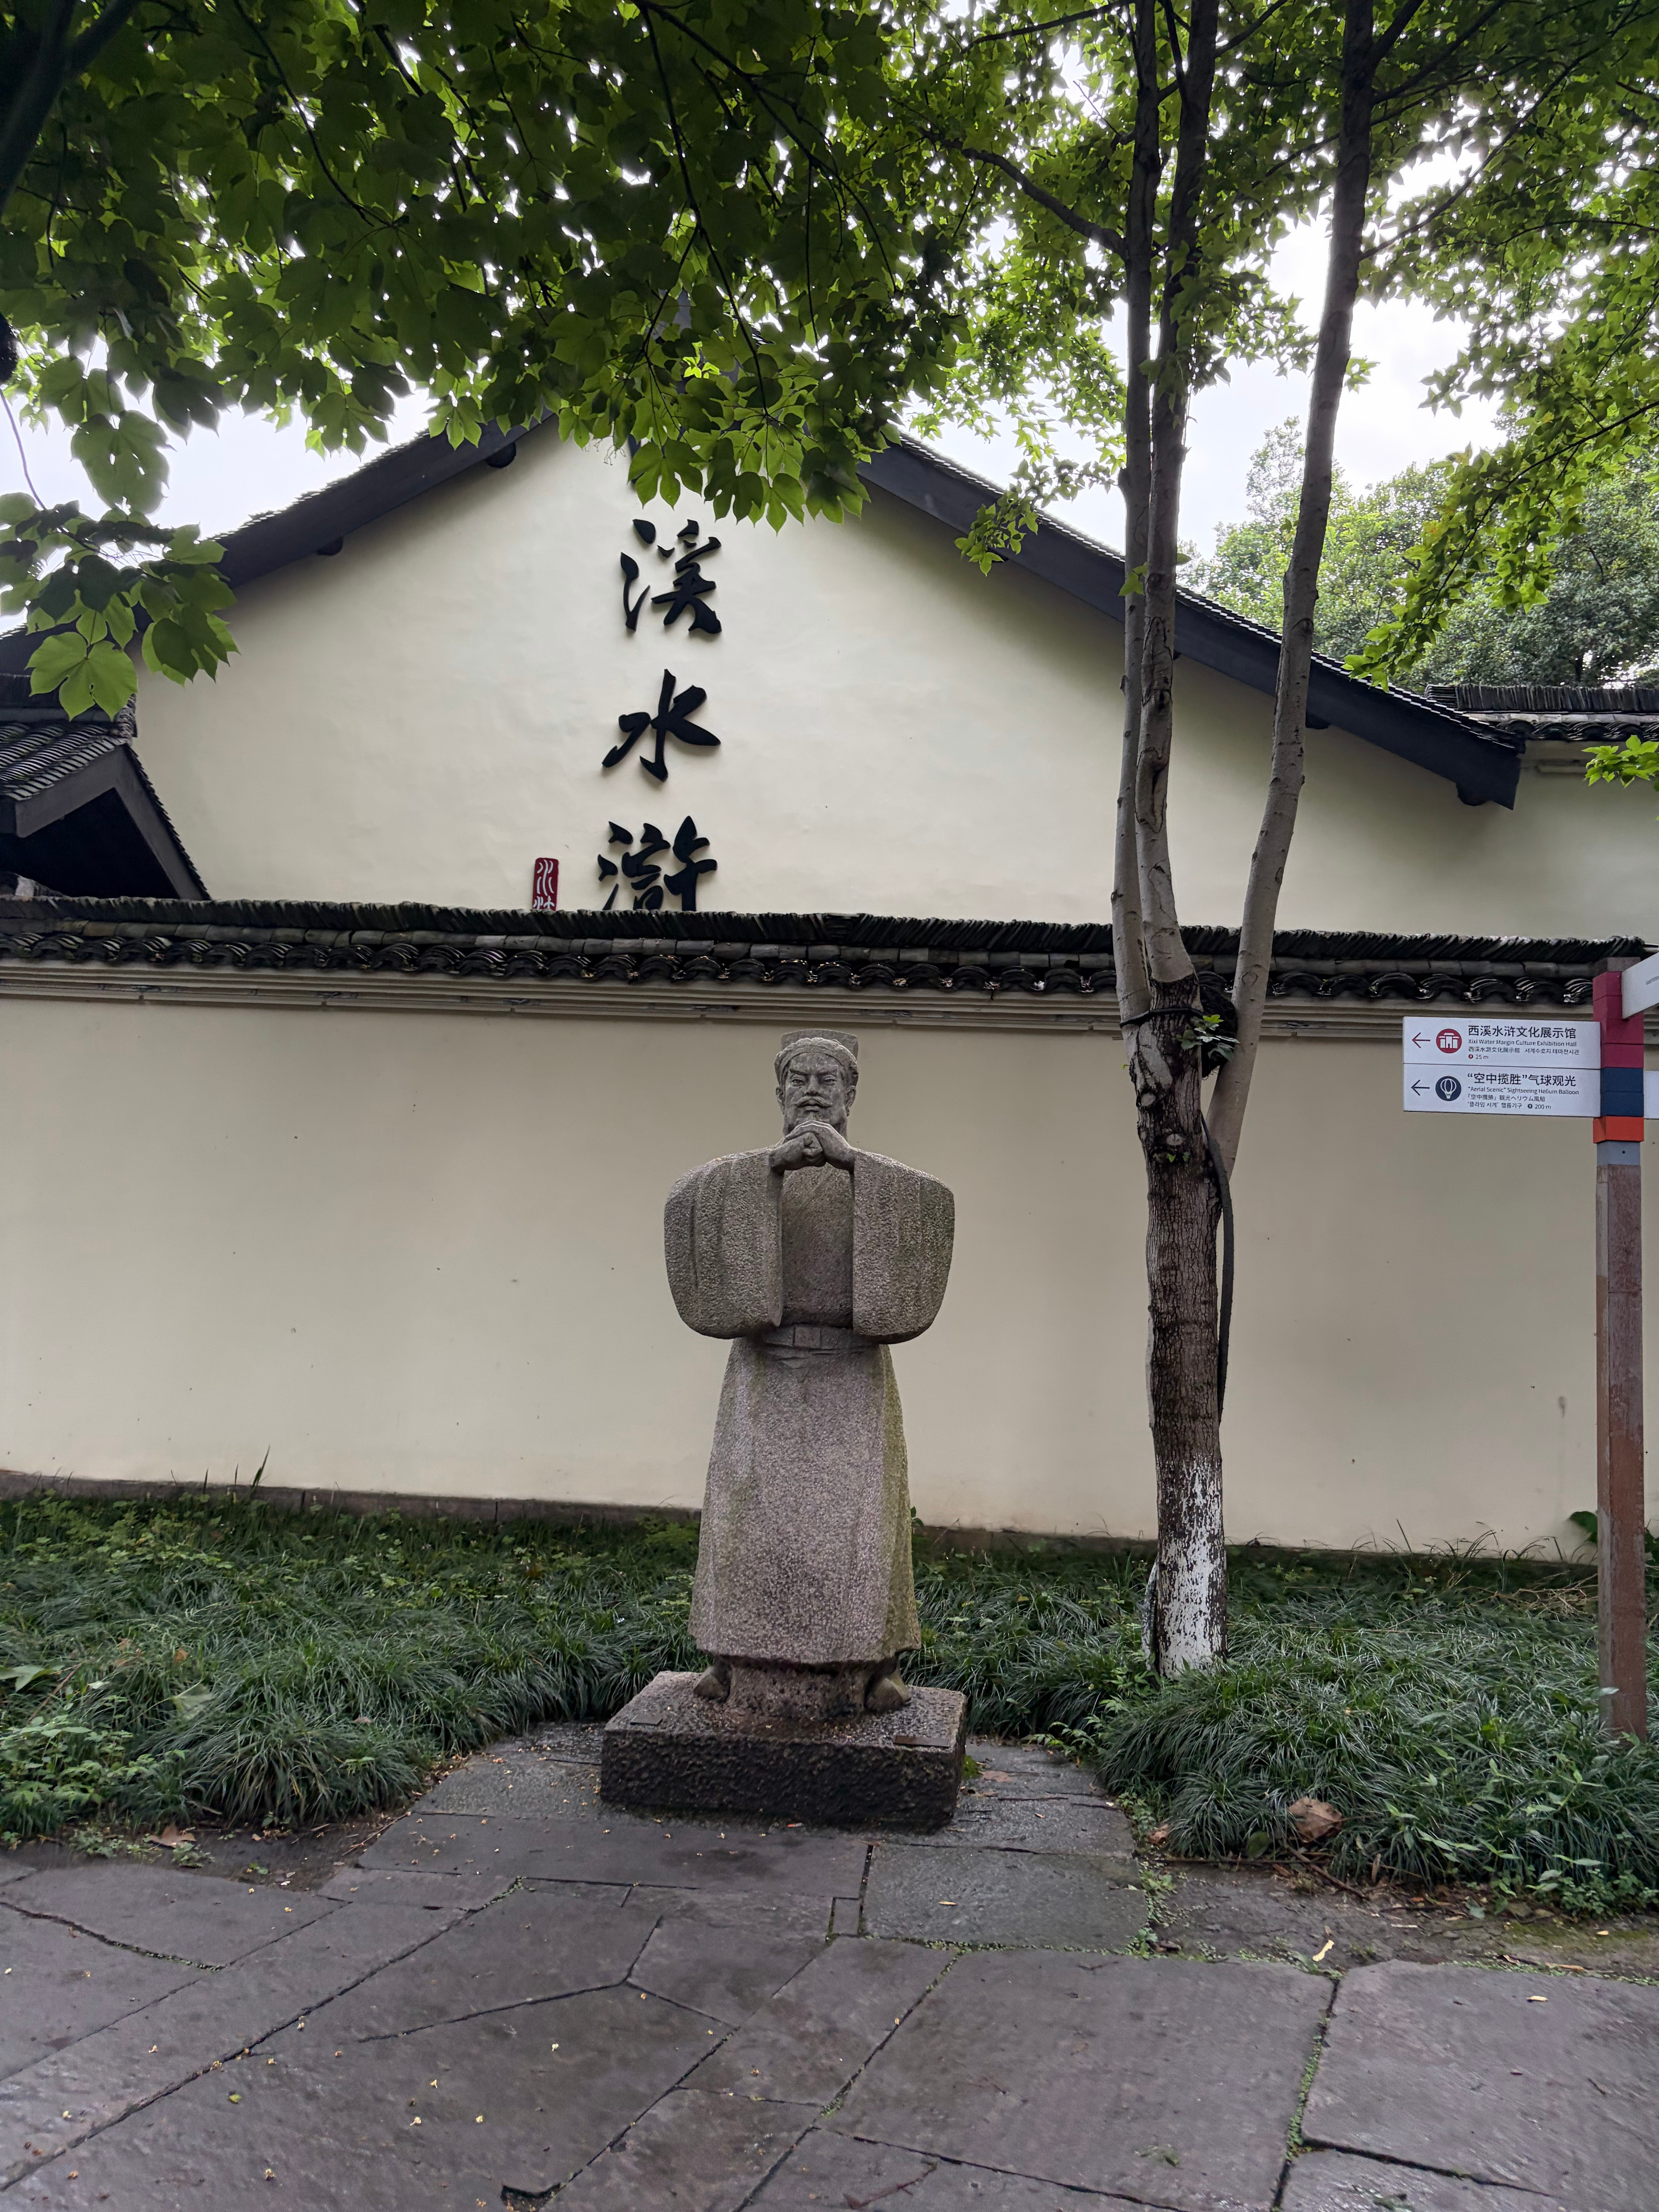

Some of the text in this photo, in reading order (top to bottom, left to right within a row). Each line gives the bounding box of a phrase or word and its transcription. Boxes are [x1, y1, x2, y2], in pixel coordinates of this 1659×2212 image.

[1468, 1025, 1576, 1039] 西溪水浒文化展示馆
[1468, 1072, 1576, 1086] “空中揽胜”气球观光
